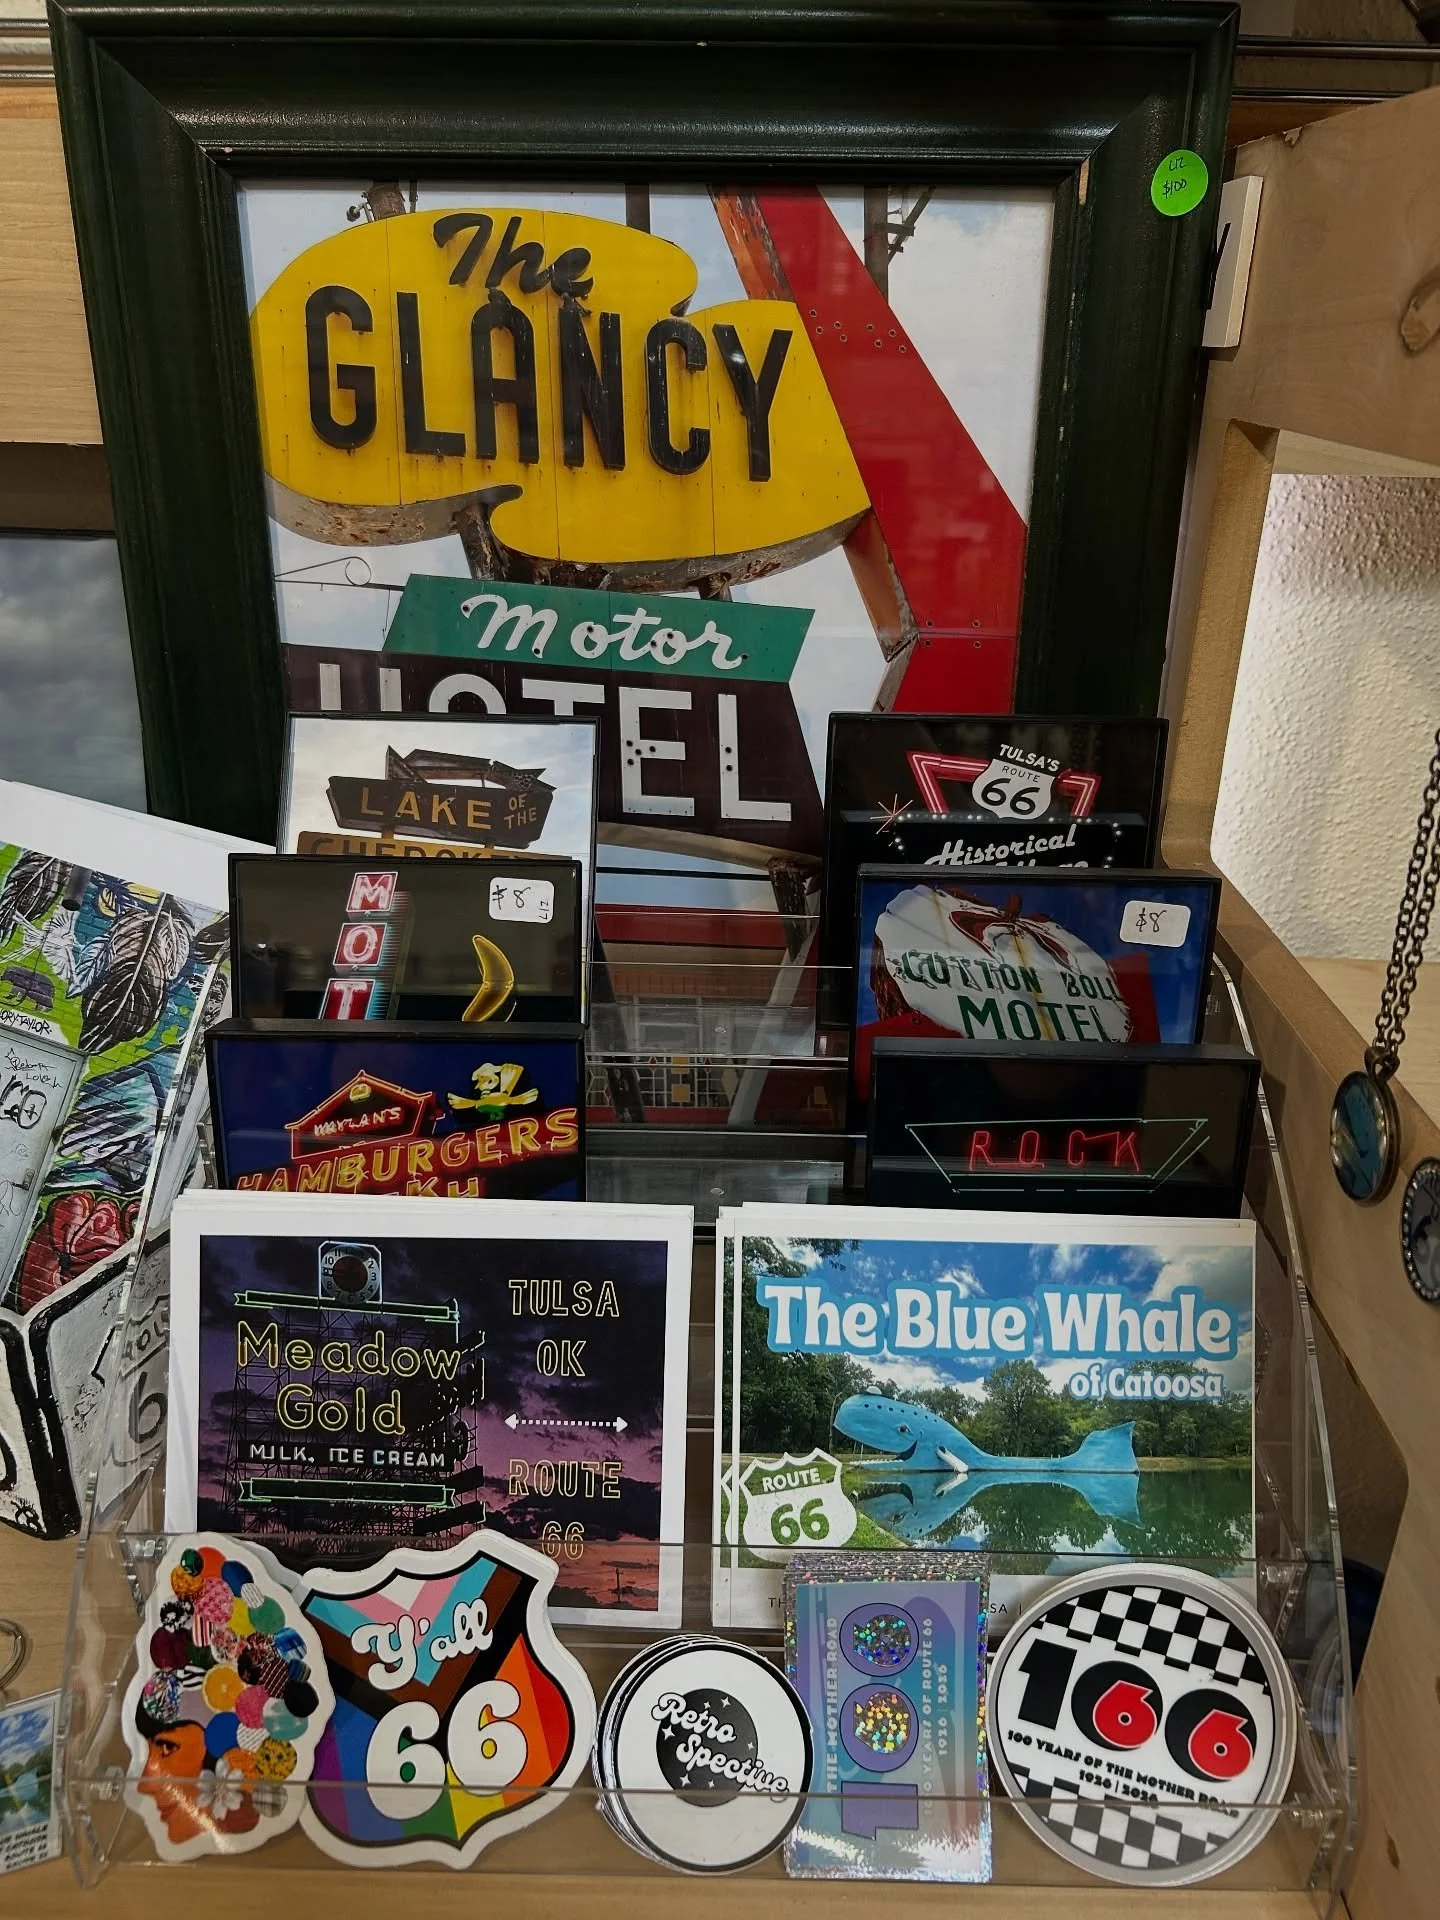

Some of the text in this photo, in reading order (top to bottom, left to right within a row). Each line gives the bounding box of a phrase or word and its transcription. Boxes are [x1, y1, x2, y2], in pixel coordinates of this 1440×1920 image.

[1162, 178, 1187, 199] $100
[433, 212, 594, 299] The
[305, 285, 793, 482] GLANCY
[460, 594, 748, 670] Motor
[999, 744, 1060, 772] TULSA'S
[1002, 765, 1040, 783] ROUTE
[361, 786, 492, 830] LAKE
[981, 778, 1040, 816] 66
[504, 807, 537, 830] THE
[924, 824, 1076, 866] Historical
[1135, 908, 1166, 933] $8
[900, 950, 1123, 1001] COTTON BOLL
[956, 995, 1124, 1042] MOTEL
[236, 1107, 580, 1192] HAMBURGERS
[968, 1130, 1141, 1171] ROCK
[509, 1279, 620, 1318] TULSA
[764, 1285, 1232, 1354] The Blue Whale
[237, 1320, 462, 1380] Meadow
[536, 1339, 587, 1377] OK
[1071, 1368, 1223, 1398] of Catoosa
[277, 1383, 405, 1435] Gold
[329, 1447, 364, 1464] ICE
[372, 1449, 445, 1467] CREAM
[509, 1459, 622, 1499] ROUTE
[762, 1467, 821, 1493] ROUTE
[541, 1521, 585, 1561] 66
[770, 1498, 830, 1545] 66
[351, 1598, 493, 1690] Y'all
[922, 1618, 933, 1639] 66
[922, 1642, 933, 1690] ROUTE
[938, 1664, 948, 1704] 2026
[651, 1692, 737, 1743] Retro
[826, 1617, 838, 1793] THE MOTHER ROAD
[922, 1695, 933, 1714] OF
[366, 1680, 528, 1819] 66
[922, 1719, 934, 1773] YEARS
[938, 1716, 948, 1755] 1926
[675, 1733, 790, 1803] Spective
[1007, 1729, 1240, 1819] 100 YEARS OF THE MOTHER ROAD
[1079, 1769, 1112, 1790] 1926
[1122, 1784, 1160, 1810] 2026
